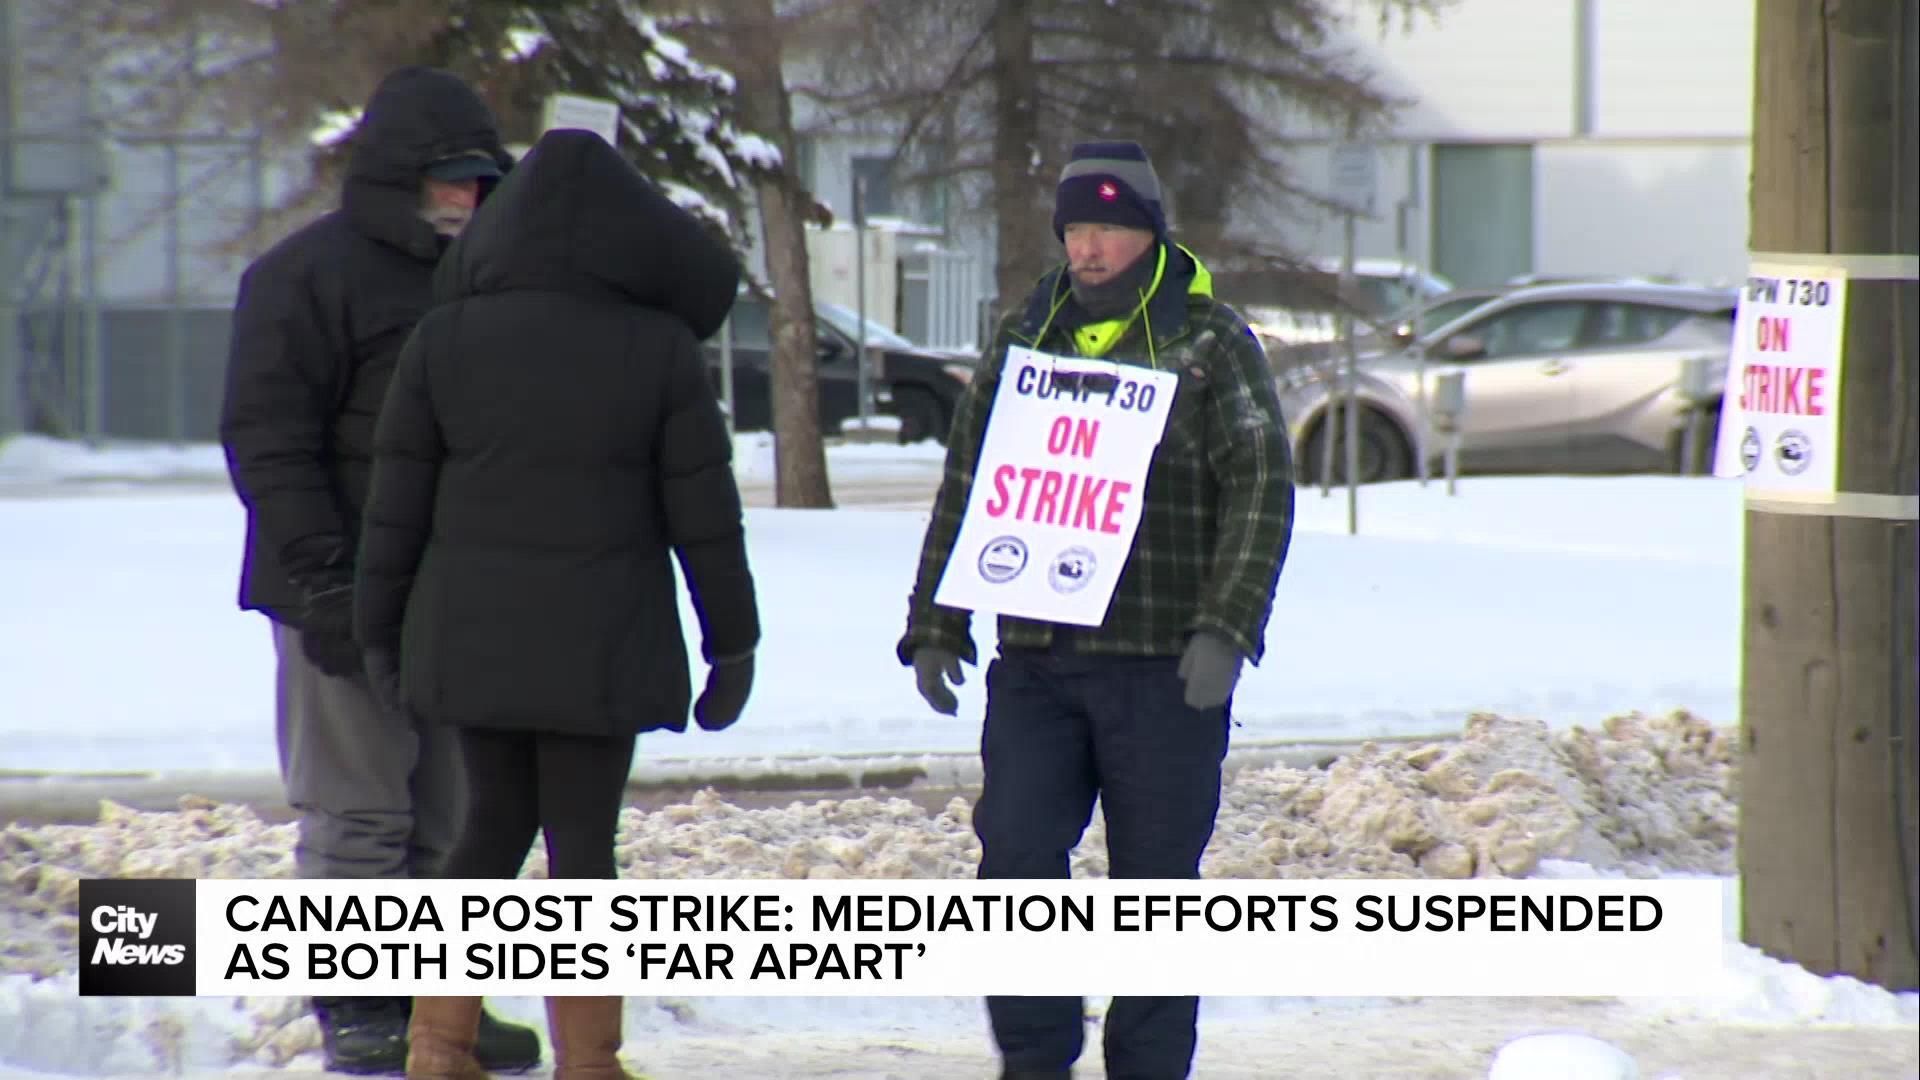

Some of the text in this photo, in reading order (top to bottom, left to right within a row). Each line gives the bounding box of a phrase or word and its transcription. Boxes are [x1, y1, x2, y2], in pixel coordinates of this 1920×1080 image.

[1786, 279, 1829, 306] 730
[1757, 317, 1788, 352] ON
[1105, 379, 1156, 412] 730
[1047, 415, 1100, 458] ON
[986, 464, 1132, 534] STRIKE
